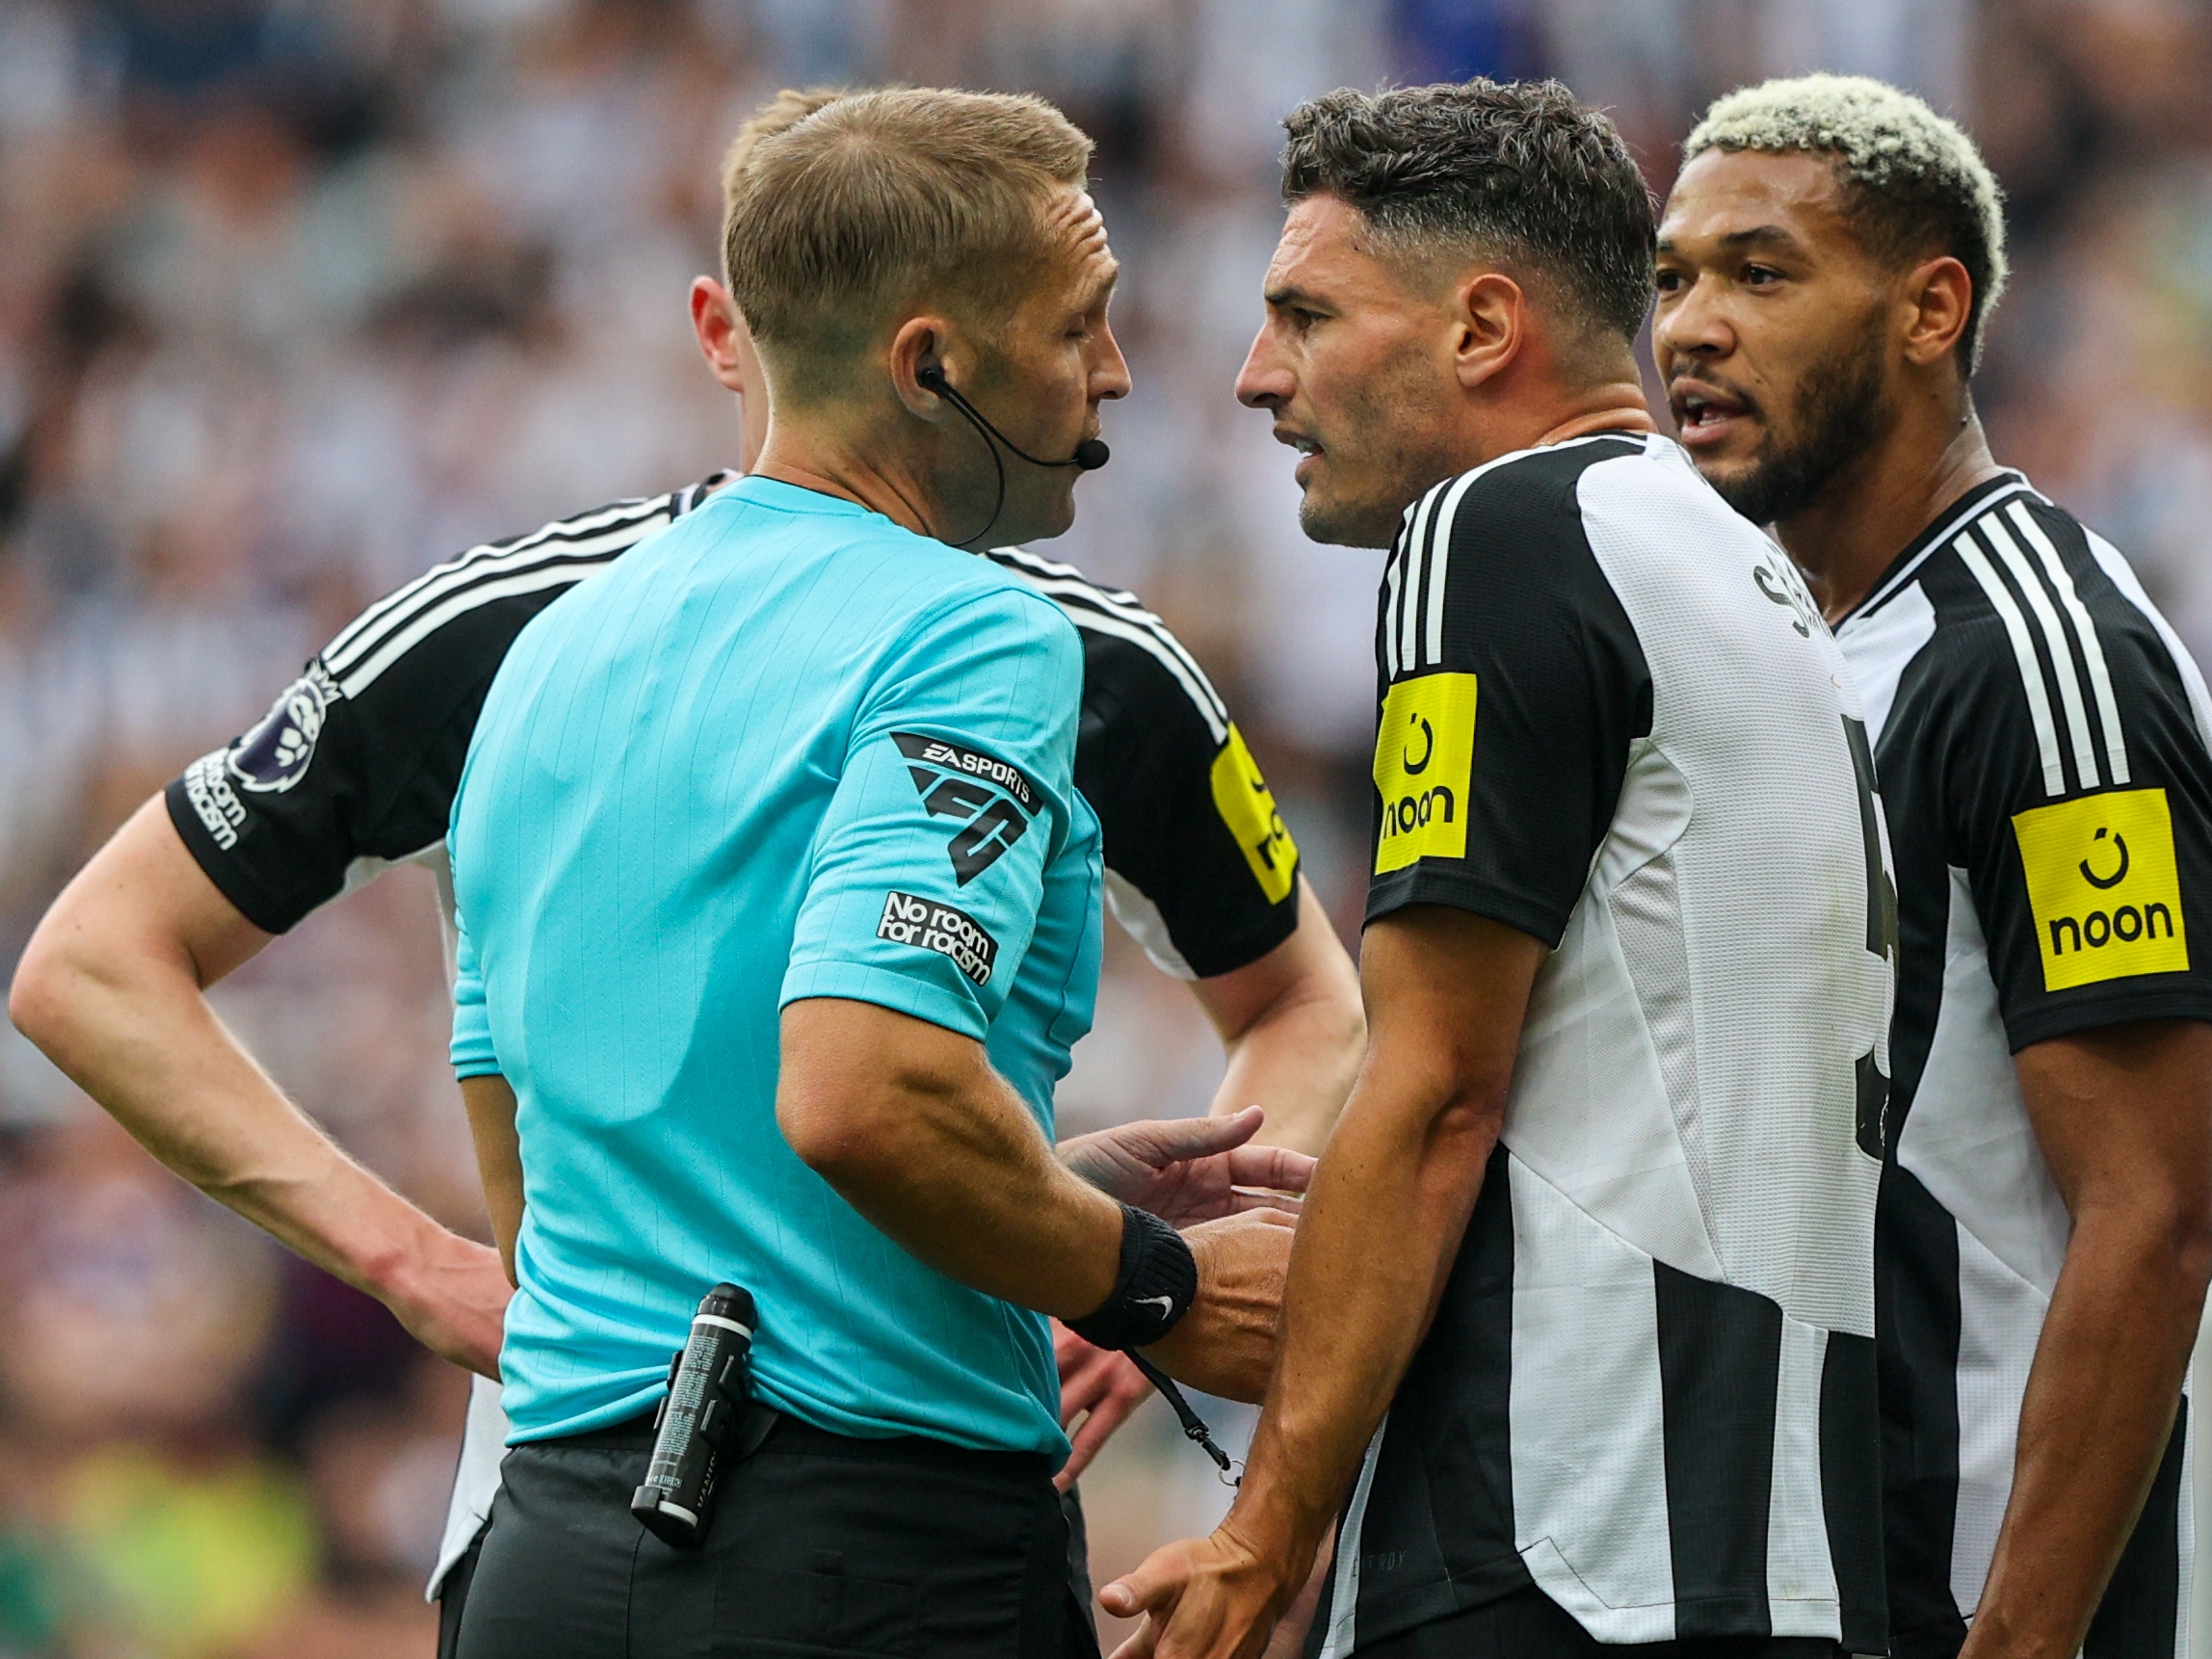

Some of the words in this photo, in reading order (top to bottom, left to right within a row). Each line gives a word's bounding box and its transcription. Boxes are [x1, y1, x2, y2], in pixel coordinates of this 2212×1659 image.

[961, 753, 1030, 803] SPORTS
[1383, 785, 1455, 840] noon
[877, 915, 922, 940] for
[921, 926, 991, 986] racism
[883, 892, 928, 923] No
[934, 907, 989, 961] room
[2048, 902, 2174, 956] noon
